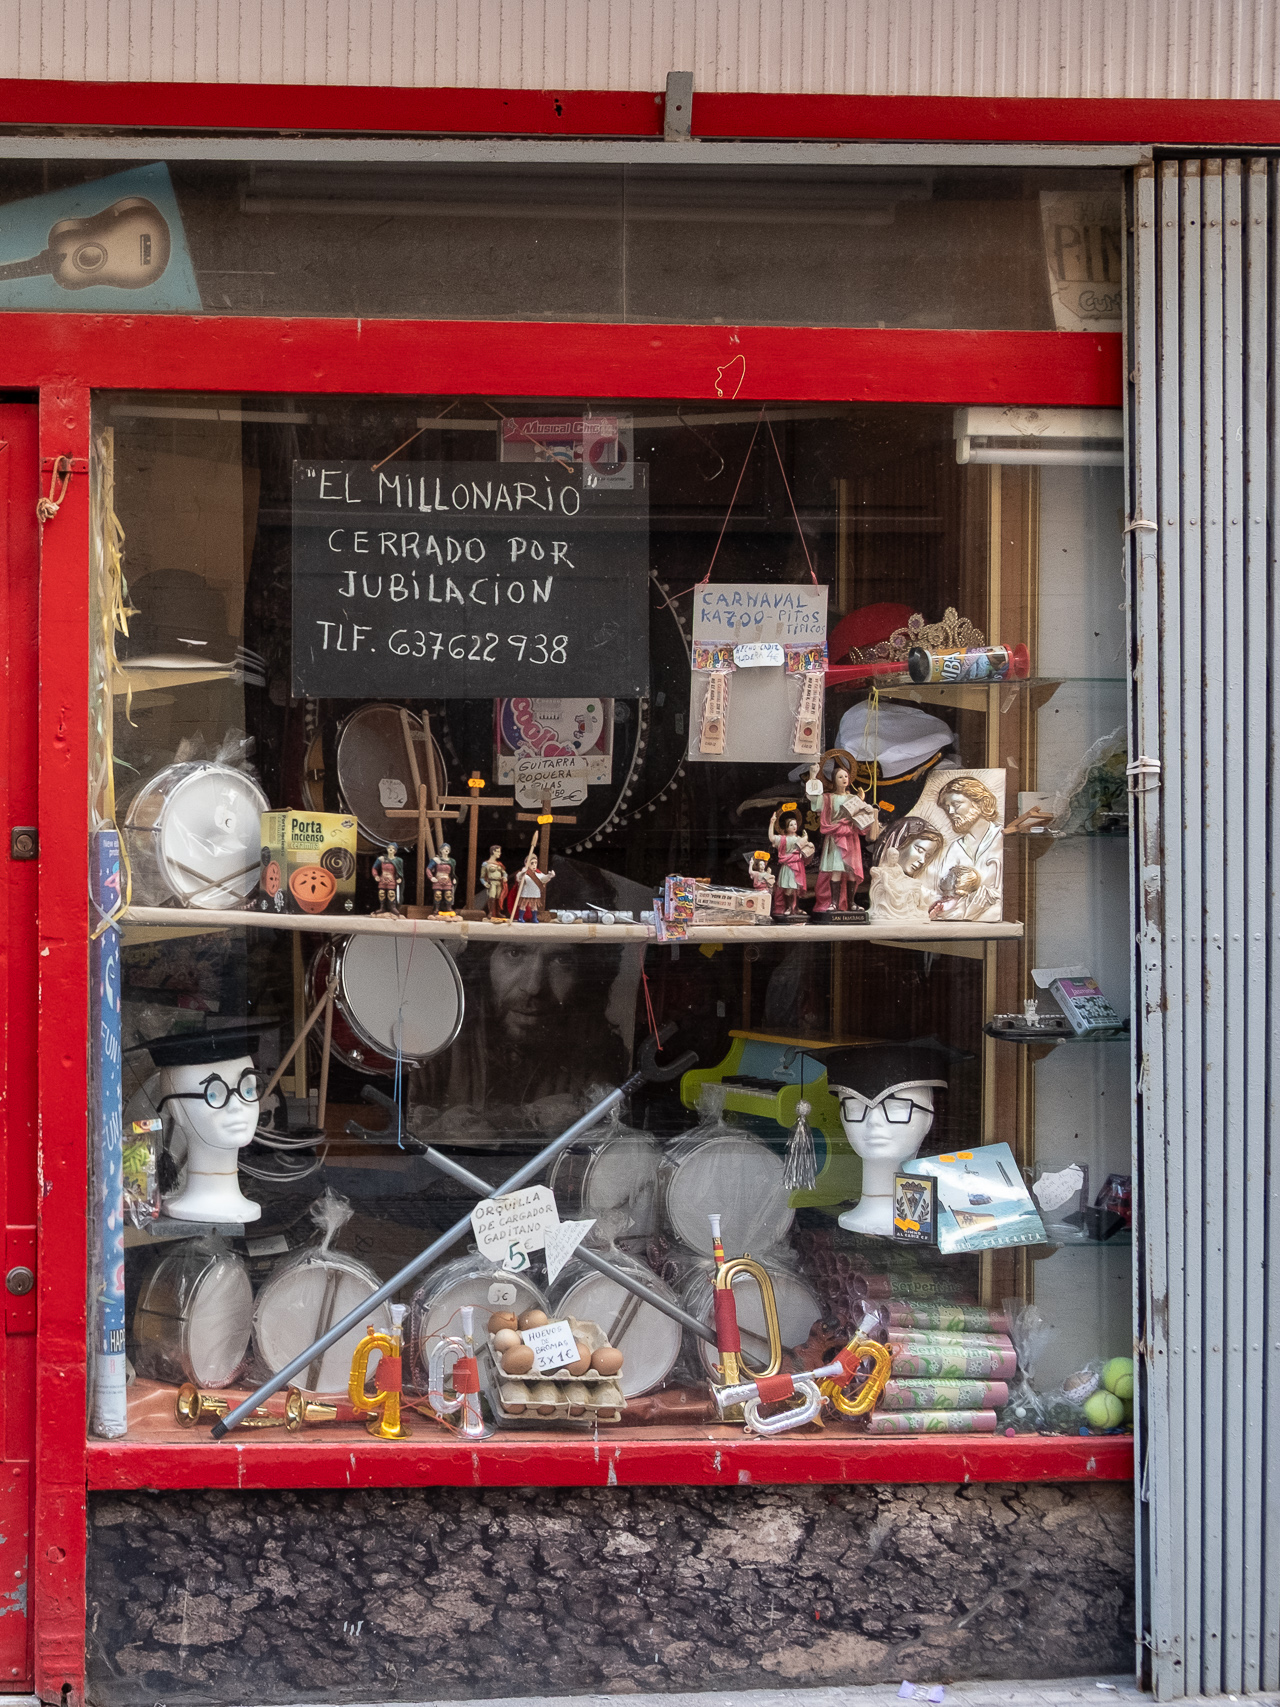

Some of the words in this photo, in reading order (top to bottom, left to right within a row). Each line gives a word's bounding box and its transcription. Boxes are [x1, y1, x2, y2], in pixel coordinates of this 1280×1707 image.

[523, 421, 570, 434] Musical
[328, 529, 486, 565] CERRADO
[508, 537, 575, 568] POR
[339, 570, 553, 606] JUBILACION
[703, 591, 808, 609] CARNAVAL
[316, 621, 376, 652] TLF.
[520, 758, 576, 771] GUITARRA
[291, 818, 322, 834] Porta
[291, 831, 324, 842] incienso
[475, 1192, 541, 1219] ORQUILLA
[478, 1220, 495, 1234] DE
[499, 1204, 553, 1226] CARGADOR
[483, 1222, 541, 1245] GADITANO
[529, 1326, 563, 1342] HUEVOS
[535, 1339, 569, 1354] BROMAS
